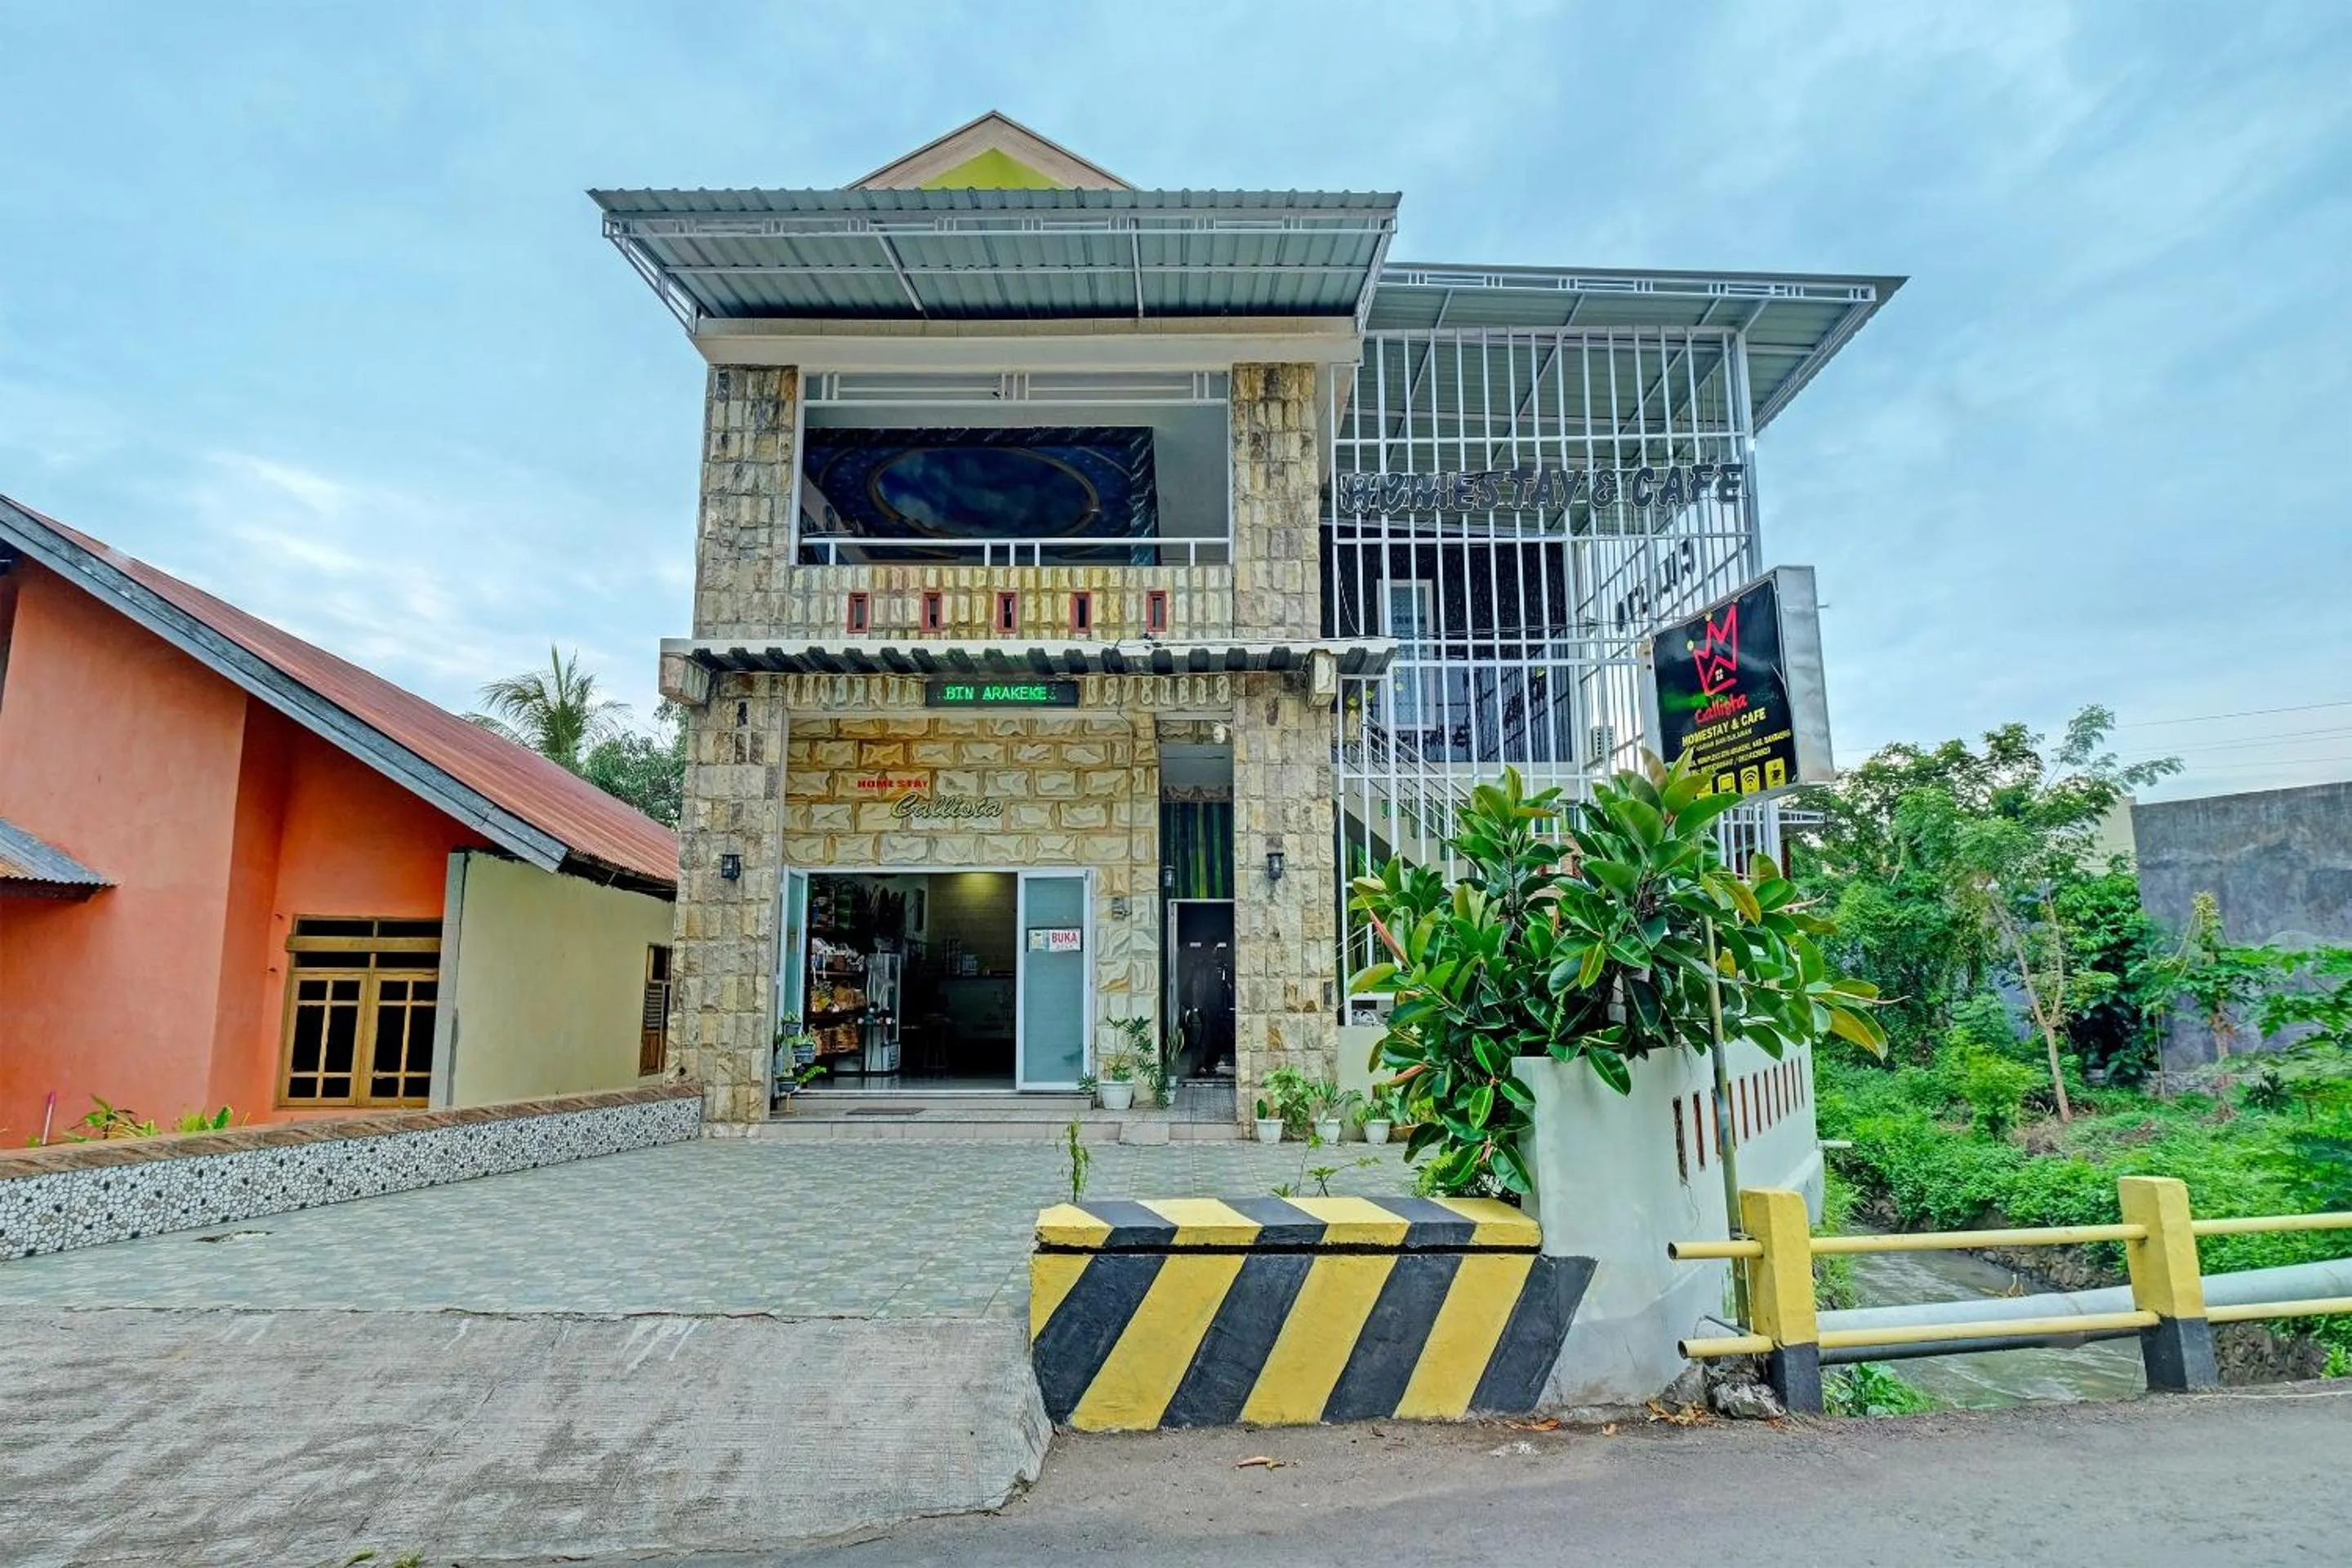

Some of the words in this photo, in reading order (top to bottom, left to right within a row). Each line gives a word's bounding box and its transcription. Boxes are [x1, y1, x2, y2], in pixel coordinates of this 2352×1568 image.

[1339, 466, 1586, 514] HOMESTAY
[1589, 468, 1618, 510] &
[1633, 463, 1744, 510] CAFE
[982, 685, 1046, 700] ARAKEKE
[1682, 720, 1728, 747] HOMESTAY
[1731, 718, 1740, 730] &
[1740, 707, 1766, 727] CAFE
[856, 779, 894, 788] HOME
[897, 779, 929, 788] STAY
[890, 792, 1004, 818] Callista
[1051, 933, 1078, 943] BUKA
